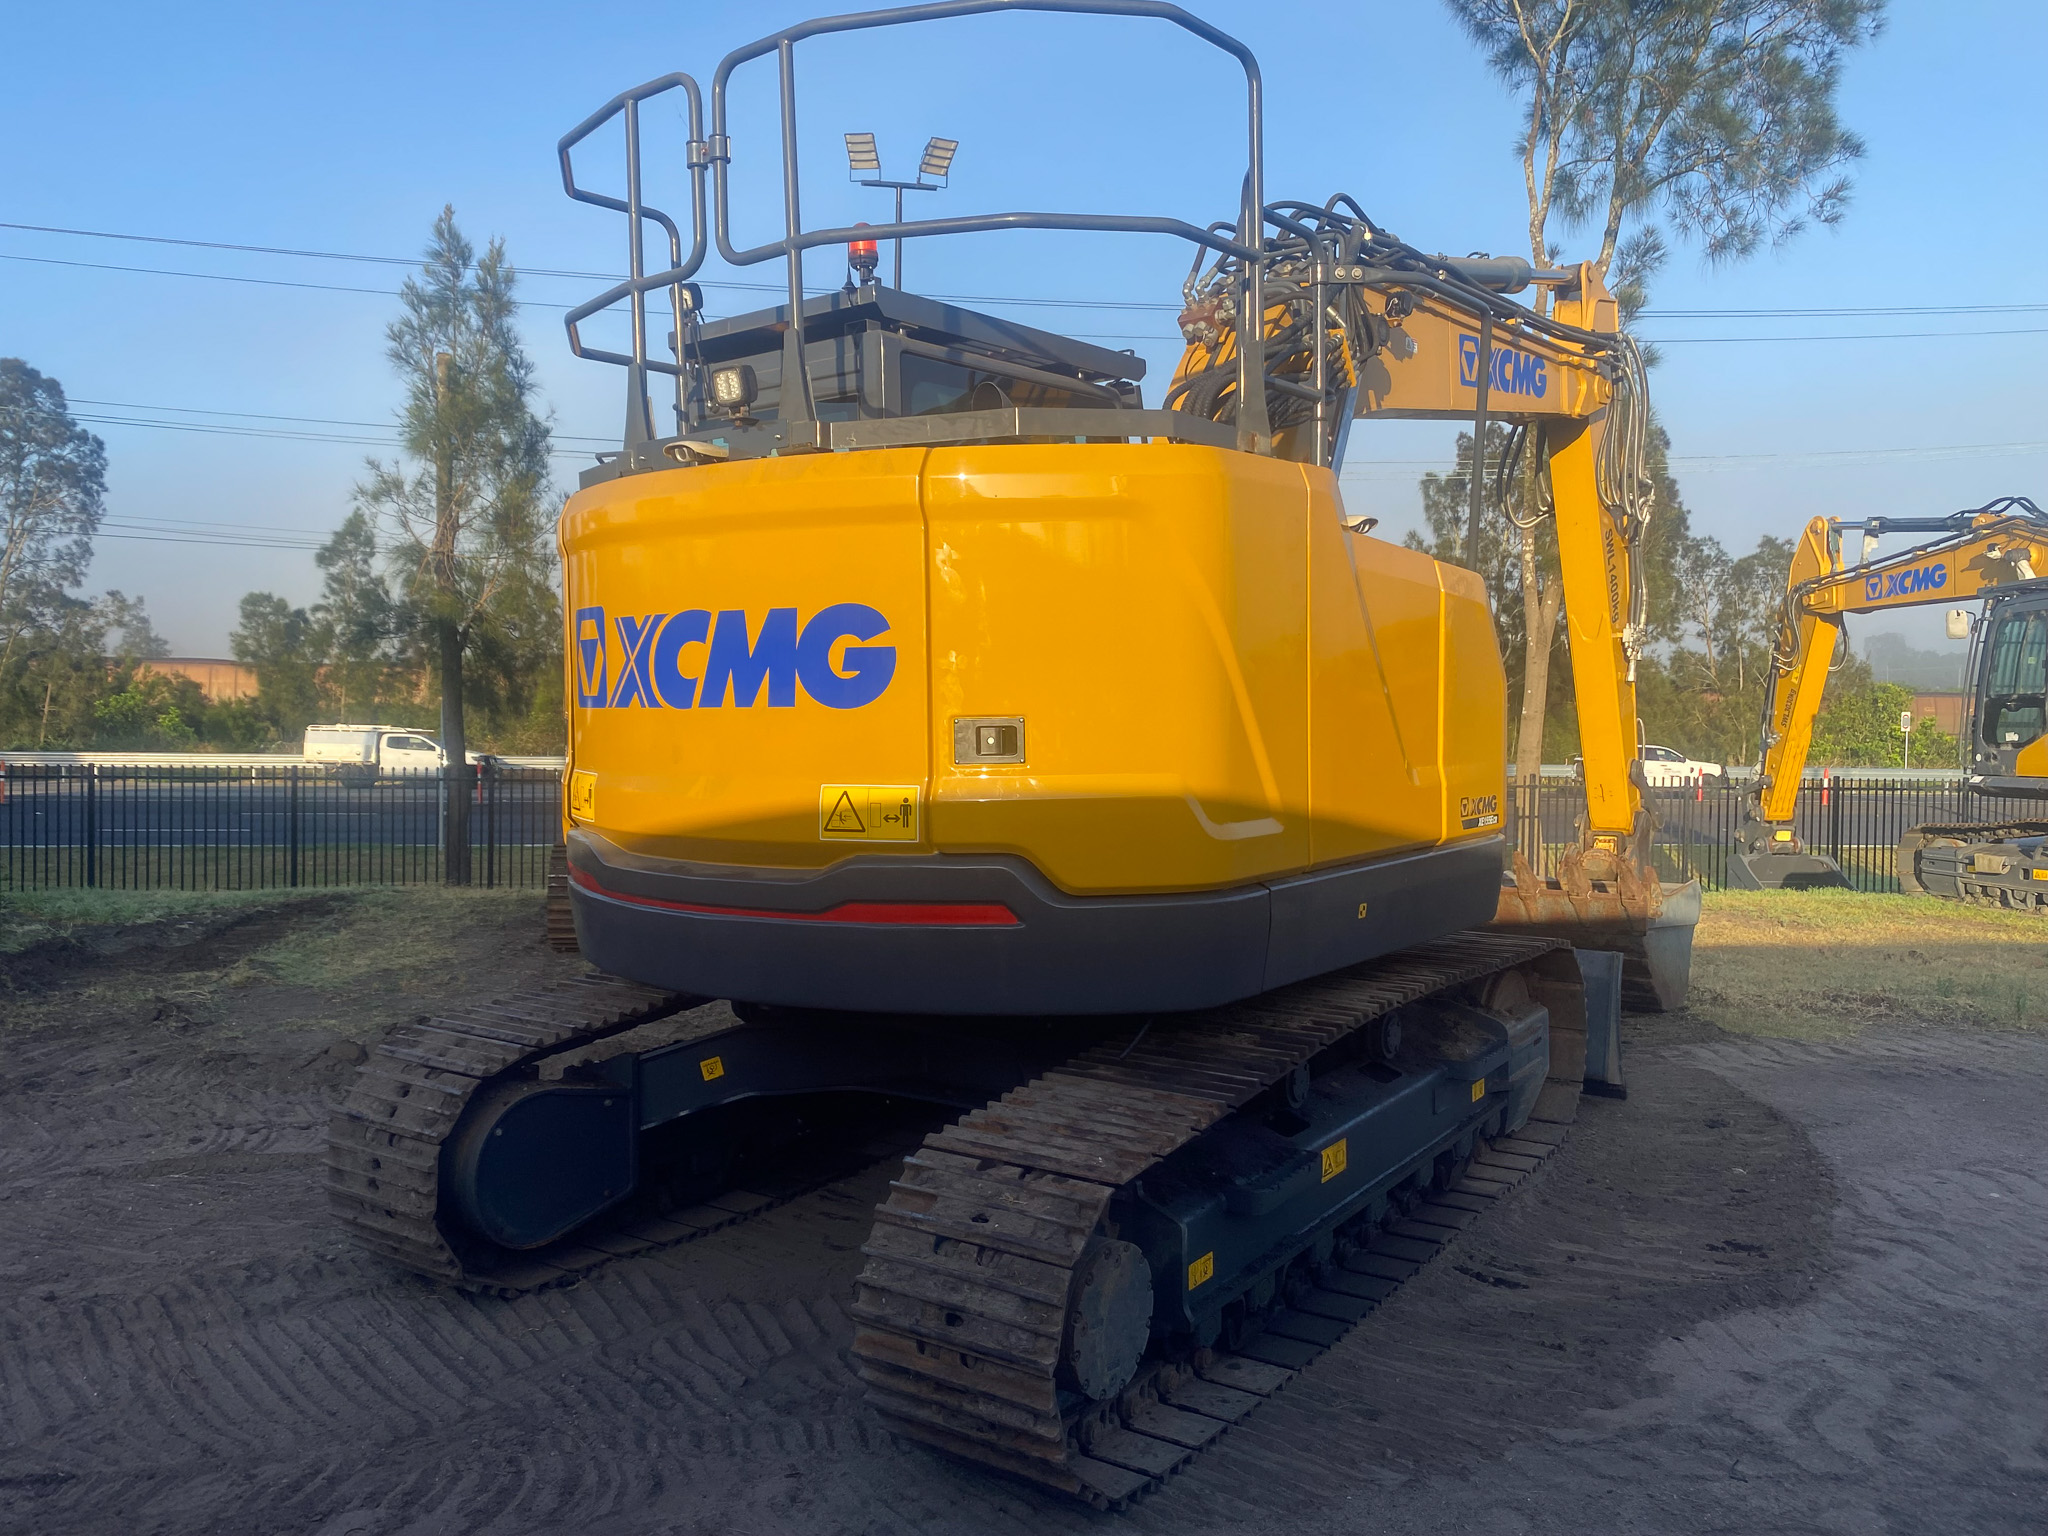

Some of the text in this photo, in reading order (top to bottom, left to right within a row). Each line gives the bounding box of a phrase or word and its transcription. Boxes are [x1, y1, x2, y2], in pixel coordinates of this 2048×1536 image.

[1488, 348, 1547, 399] XCMG
[1604, 528, 1620, 624] SWL1400kg
[1883, 563, 1948, 598] XCMG
[607, 603, 897, 709] XCMG
[1470, 795, 1498, 816] XCMG
